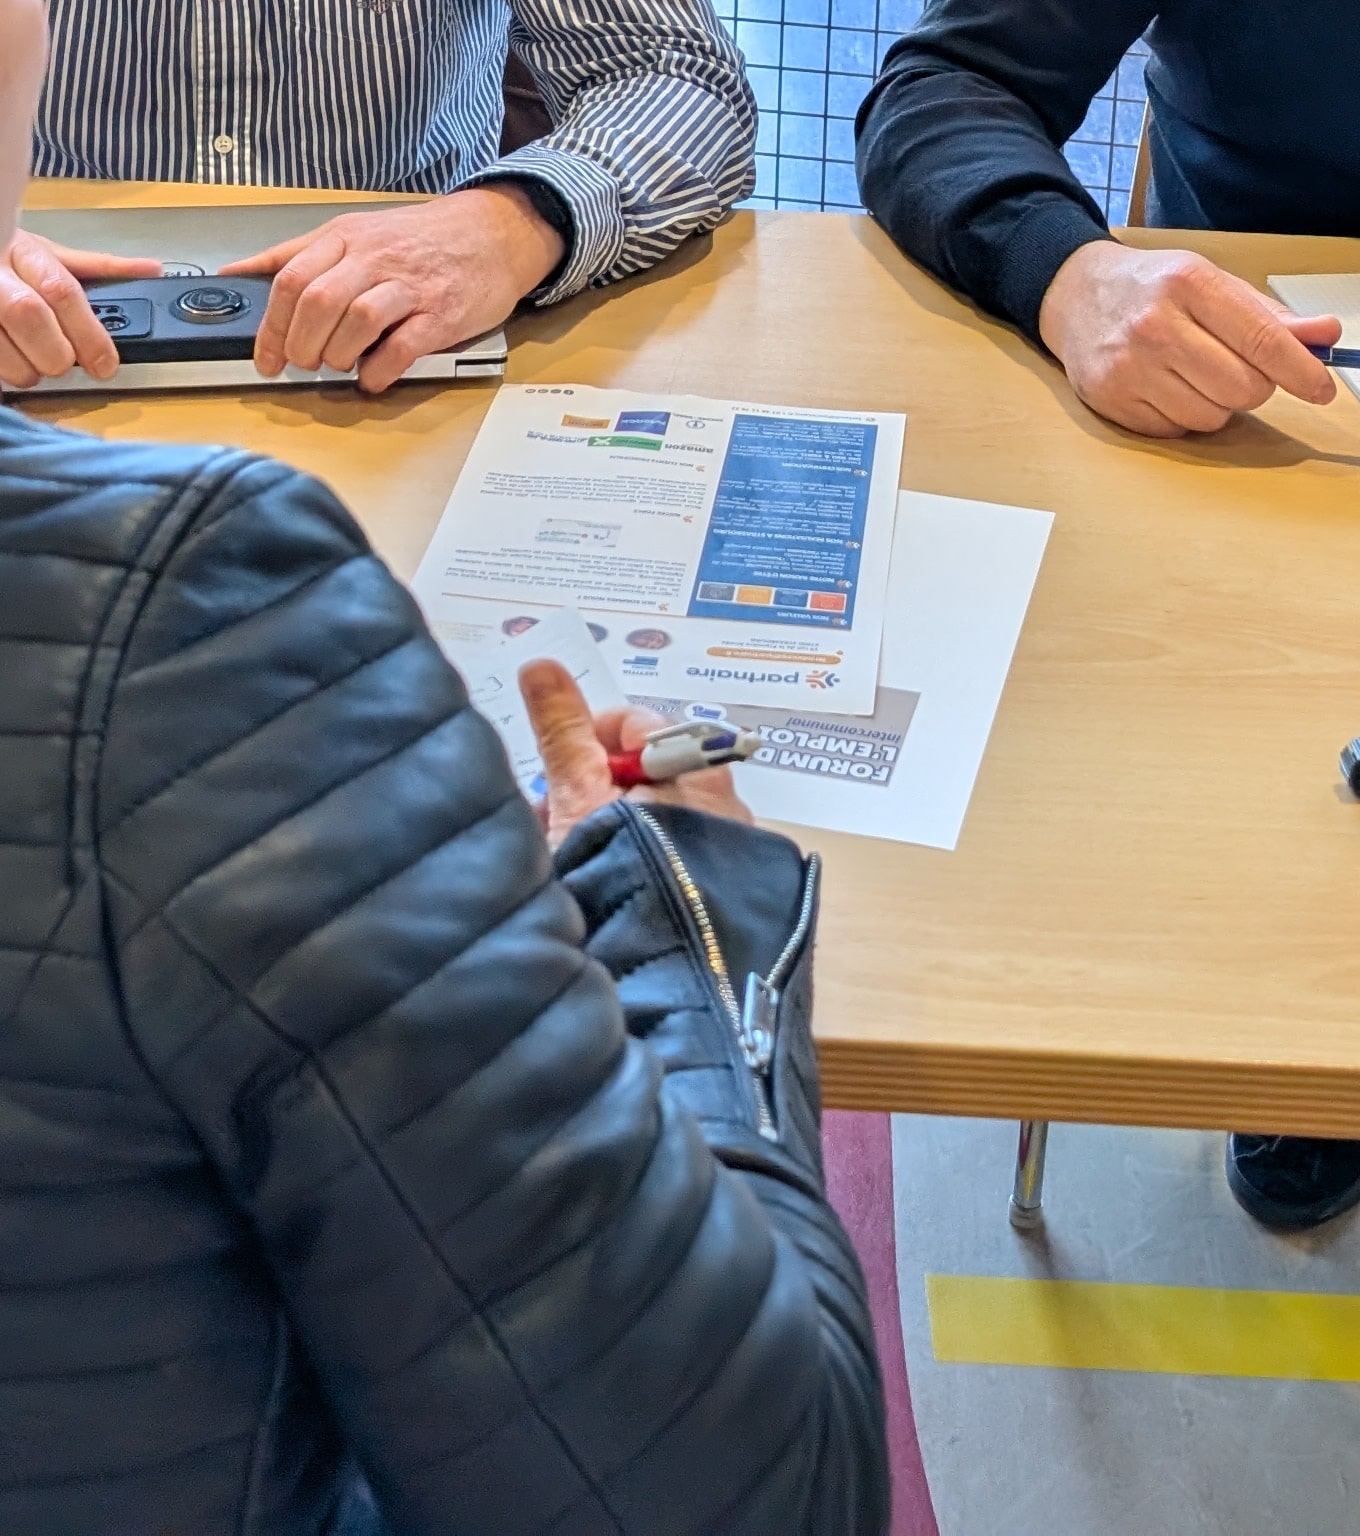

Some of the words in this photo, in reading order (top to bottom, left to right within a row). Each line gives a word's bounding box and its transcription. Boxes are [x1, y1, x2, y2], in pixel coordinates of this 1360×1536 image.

[665, 443, 713, 453] amazon
[686, 666, 799, 686] partnaire
[756, 724, 897, 762] L'EMPLOI
[787, 716, 901, 743] intercommunal
[778, 746, 890, 782] FORUM
